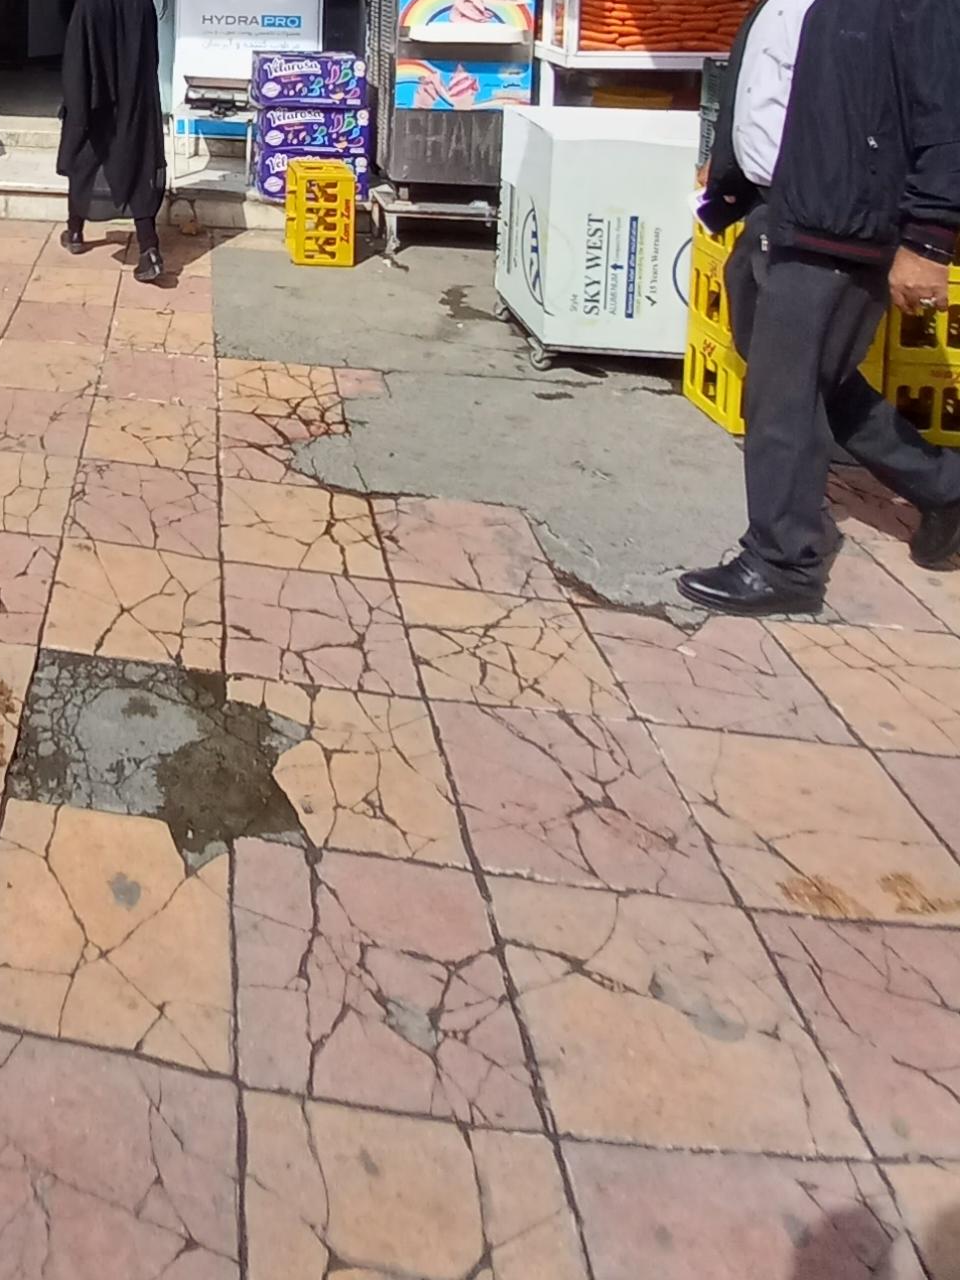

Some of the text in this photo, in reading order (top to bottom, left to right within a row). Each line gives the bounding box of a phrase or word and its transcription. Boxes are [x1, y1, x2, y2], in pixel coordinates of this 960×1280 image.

[202, 15, 300, 27] HYDRA PRO
[583, 213, 605, 316] SKY WEST
